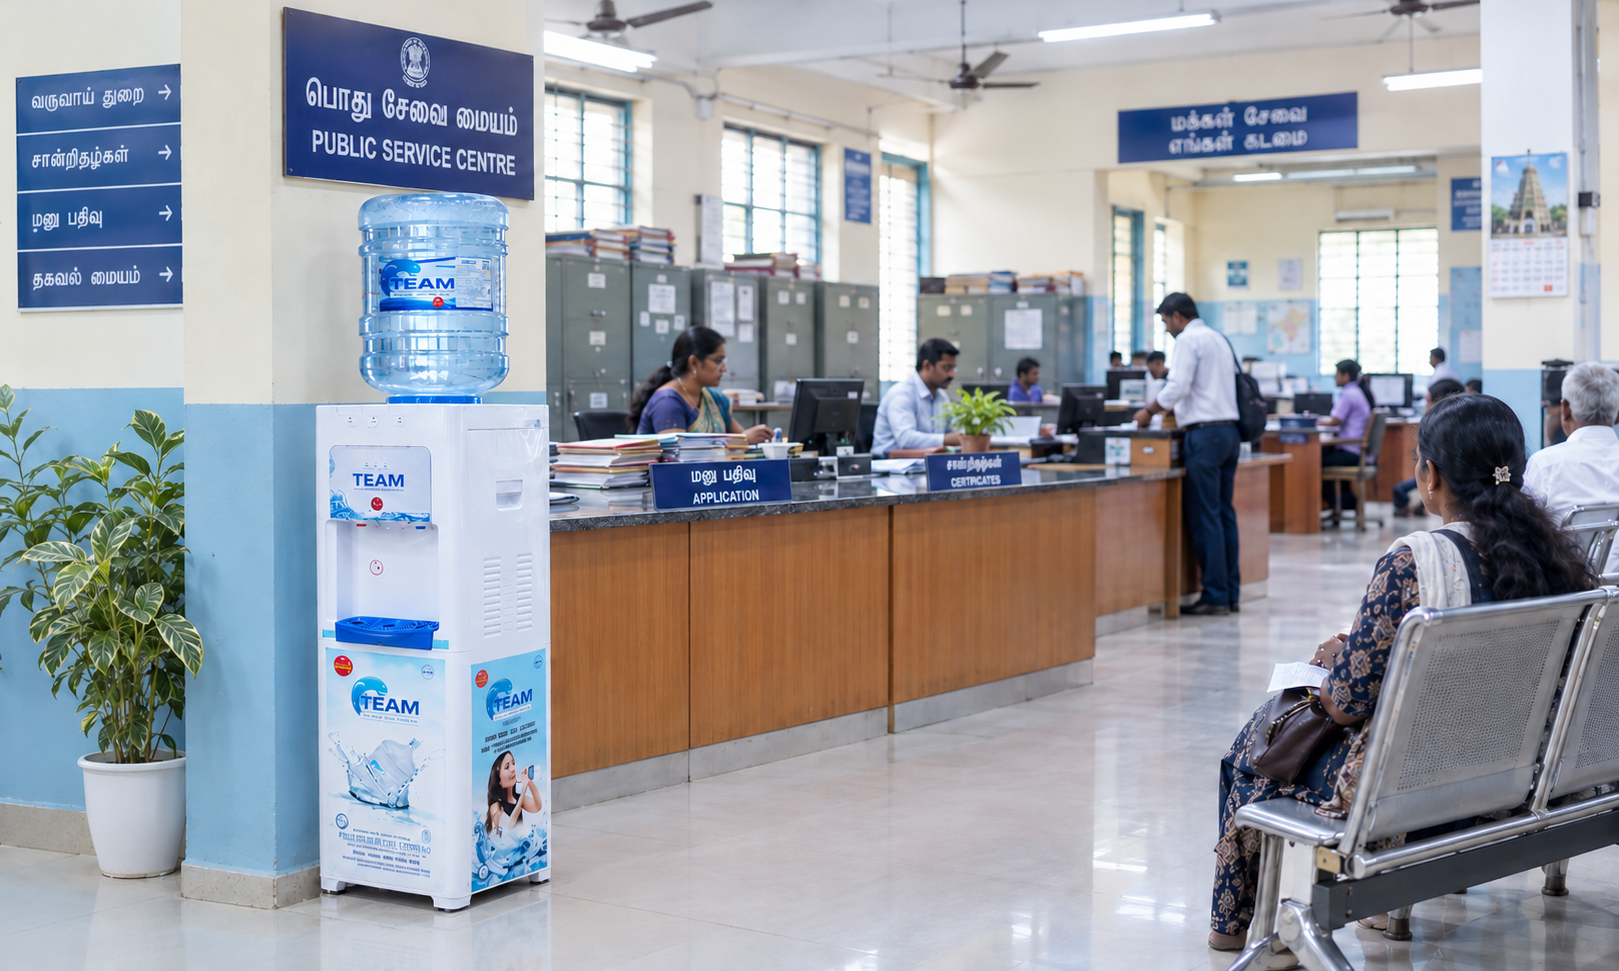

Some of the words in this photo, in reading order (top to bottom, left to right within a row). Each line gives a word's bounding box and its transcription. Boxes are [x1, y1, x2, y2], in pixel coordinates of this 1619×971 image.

[31, 86, 95, 112] வருவாய்
[102, 87, 145, 109] துறை
[306, 76, 372, 123] பொது
[381, 88, 448, 127] சேவை
[456, 106, 518, 137] மையம்
[1170, 106, 1235, 132] மக்கள்
[1243, 105, 1308, 127] சேவை
[312, 129, 377, 160] PUBLIC
[382, 138, 452, 169] SERVICE
[456, 148, 516, 176] CENTRE
[1168, 130, 1234, 155] எங்கள்
[31, 144, 130, 171] சான்றிதழ்கள்
[67, 206, 103, 229] பதிவு
[32, 266, 82, 291] தகவல்
[90, 264, 141, 286] மையம்
[390, 277, 455, 290] TEAM
[352, 473, 404, 488] TEAM
[691, 470, 718, 486] மனு
[723, 464, 757, 484] பதிவு
[692, 489, 760, 505] APPLICATION
[360, 695, 420, 716] TEAM
[493, 688, 533, 712] TEAM
